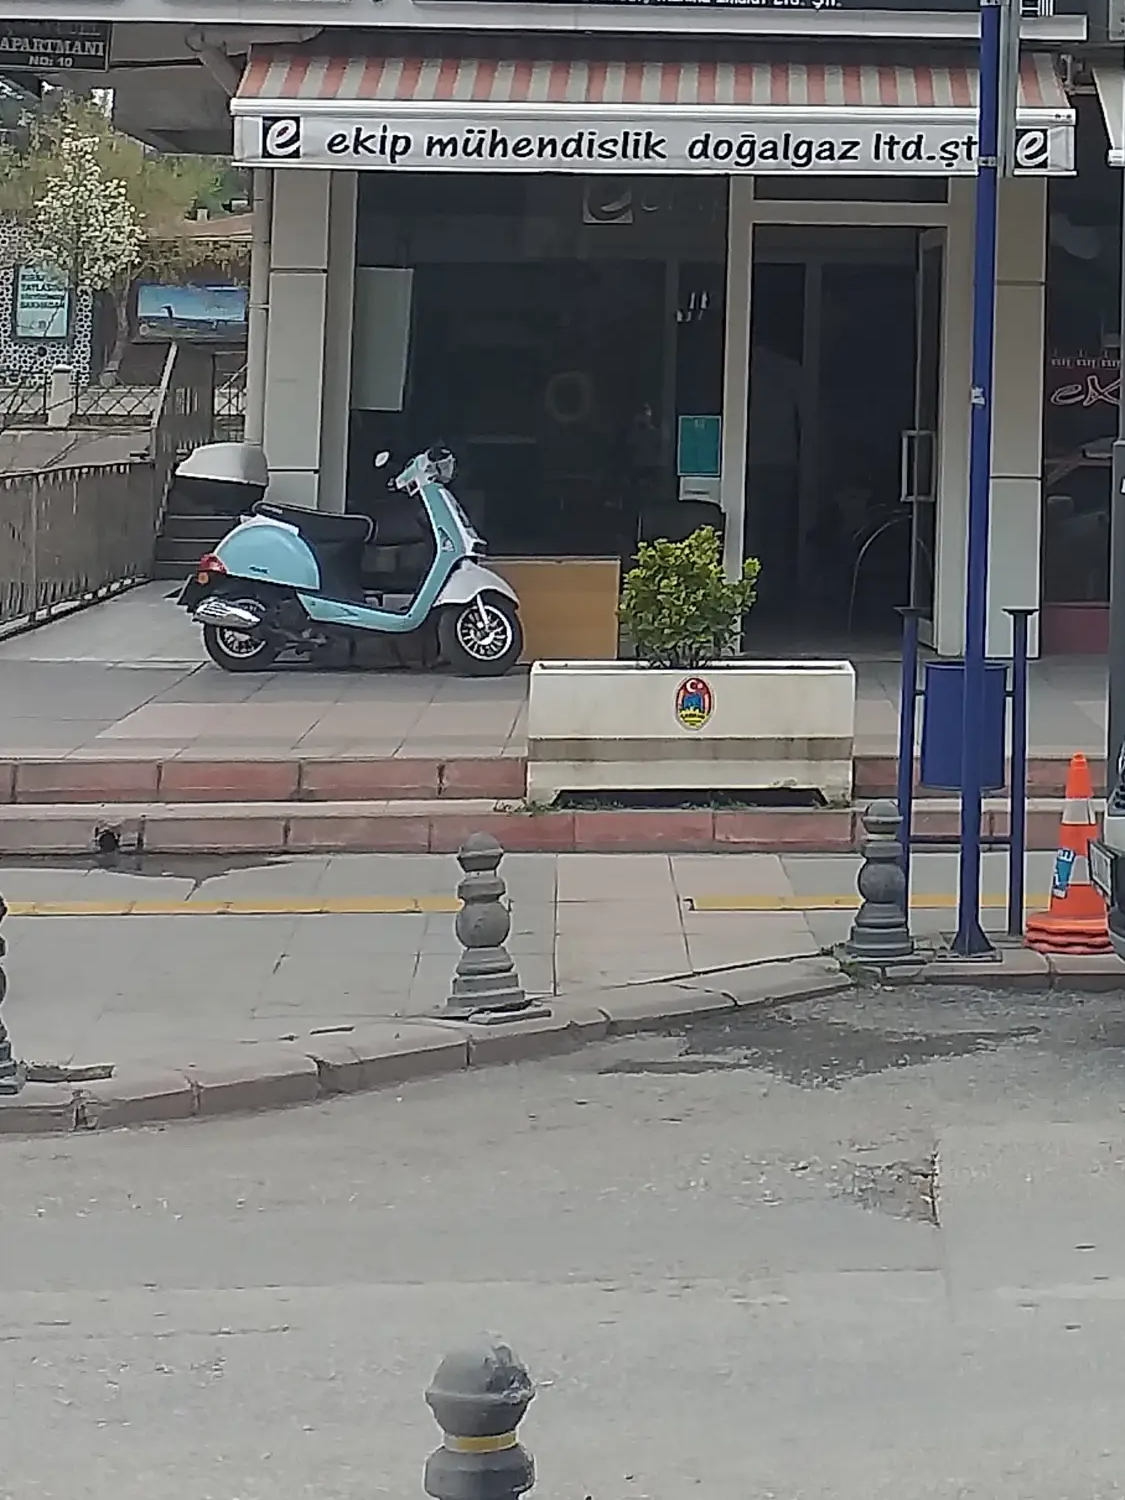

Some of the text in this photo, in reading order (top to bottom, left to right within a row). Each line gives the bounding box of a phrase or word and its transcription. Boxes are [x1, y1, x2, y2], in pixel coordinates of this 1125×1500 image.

[0, 37, 105, 56] APARTMANI
[326, 123, 412, 164] ekip
[425, 124, 667, 161] mühendislik
[687, 130, 861, 169] doğalgaz
